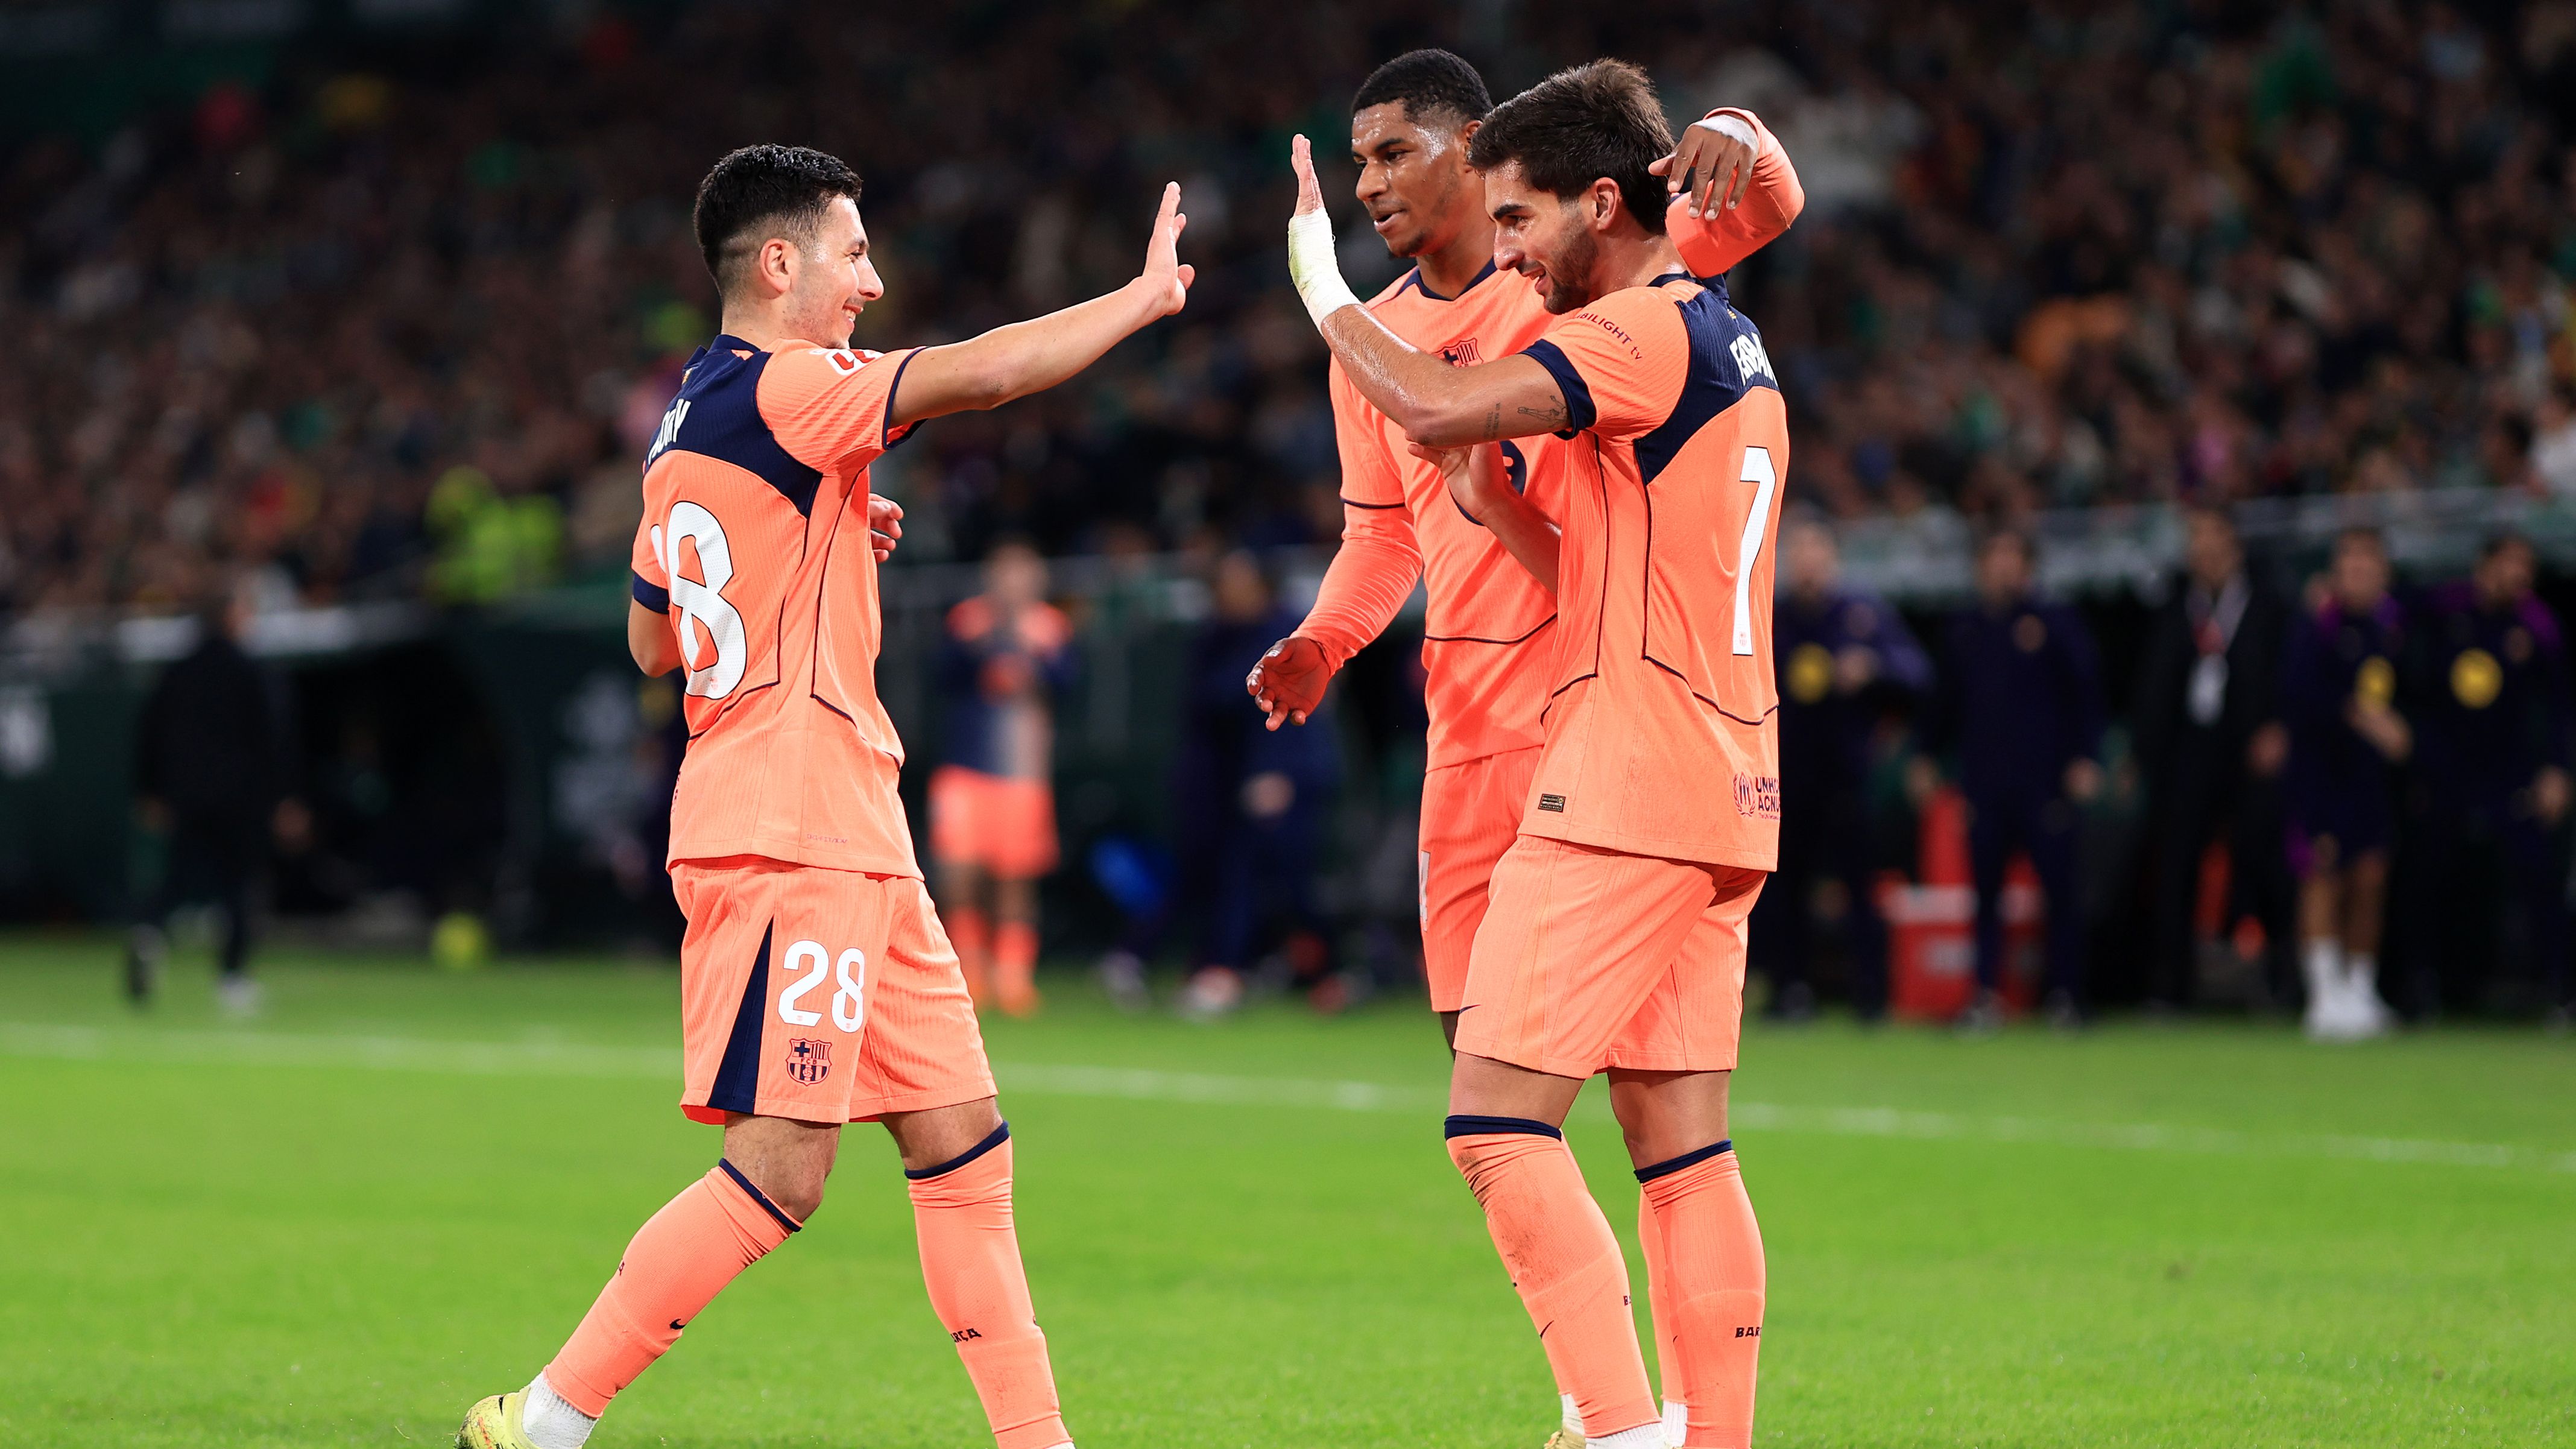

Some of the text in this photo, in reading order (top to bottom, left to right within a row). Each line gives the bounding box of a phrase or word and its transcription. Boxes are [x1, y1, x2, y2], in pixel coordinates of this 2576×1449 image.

[1577, 312, 1643, 360] BILIGHT tv
[1732, 446, 1776, 655] 7
[778, 939, 865, 1033] 28
[1735, 1327, 1762, 1338] BAR
